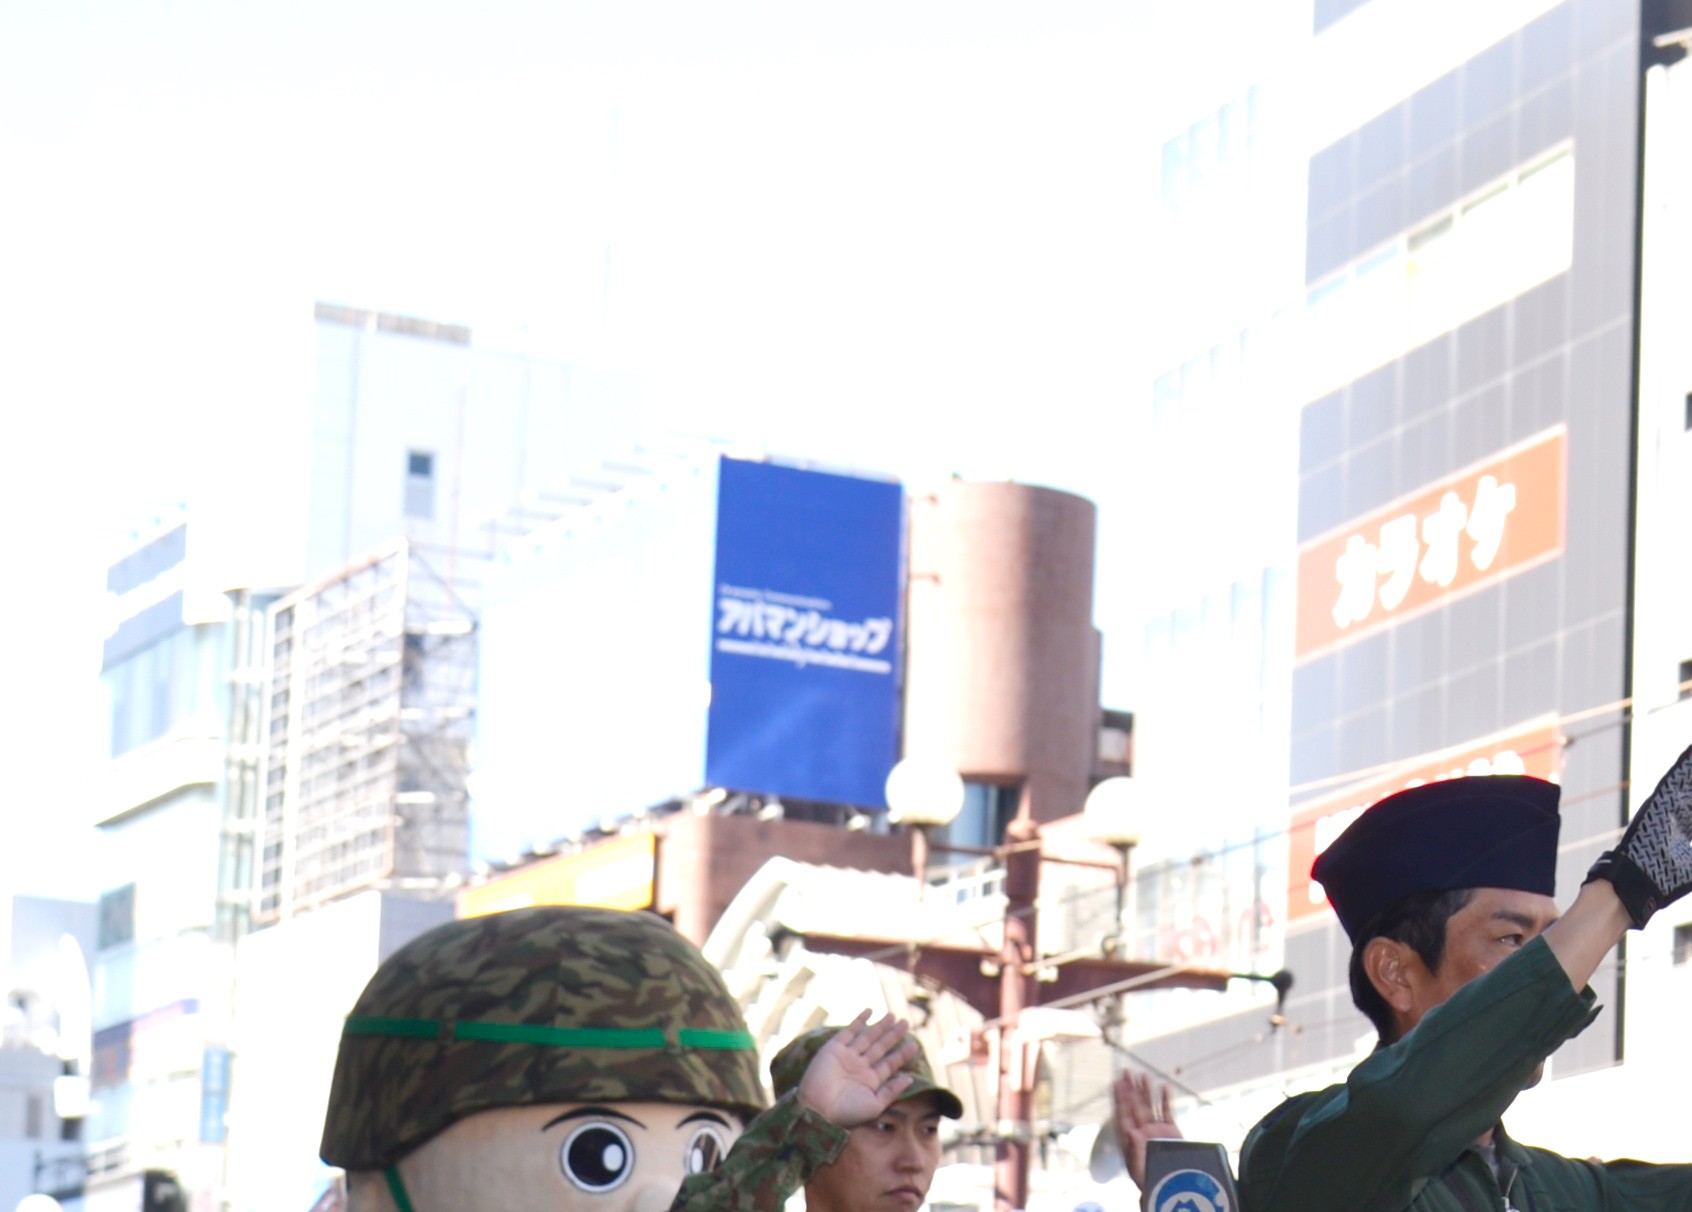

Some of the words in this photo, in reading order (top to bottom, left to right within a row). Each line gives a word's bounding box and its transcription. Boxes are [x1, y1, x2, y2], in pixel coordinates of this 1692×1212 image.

[1331, 475, 1516, 629] カラオケ
[717, 596, 893, 655] アパマンショップ
